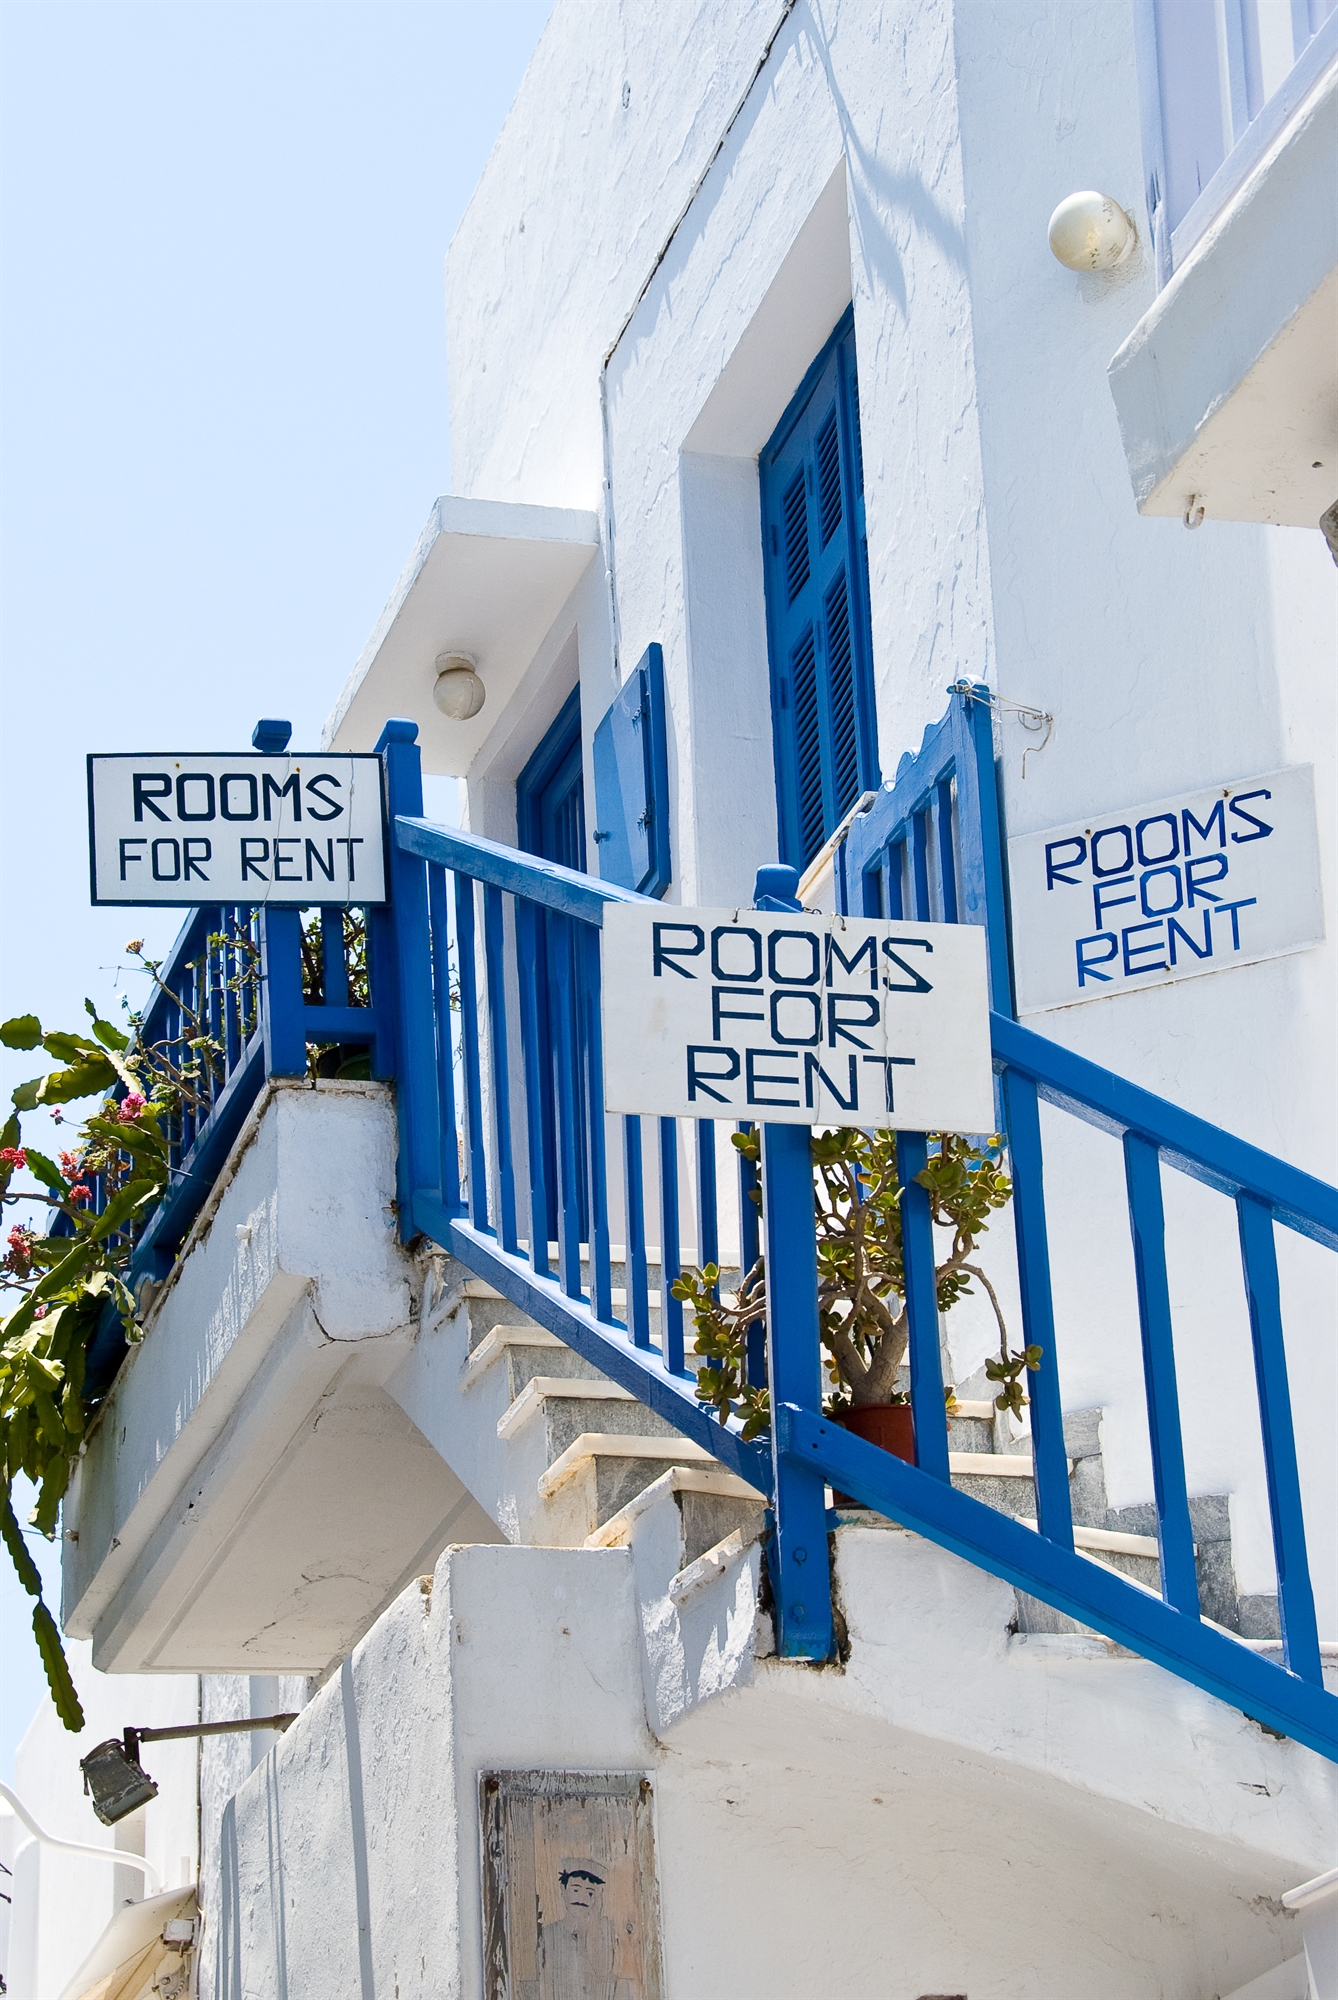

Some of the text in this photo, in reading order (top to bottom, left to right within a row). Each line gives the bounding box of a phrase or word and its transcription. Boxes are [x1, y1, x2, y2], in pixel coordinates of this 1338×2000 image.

[132, 772, 345, 822] ROOMS
[118, 837, 364, 882] FOR RENT
[1044, 788, 1275, 891] ROOMS
[1092, 852, 1229, 931] FOR
[652, 921, 934, 994] ROOMS
[1075, 897, 1257, 988] RENT
[711, 985, 881, 1051] FOR
[686, 1044, 916, 1113] RENT
